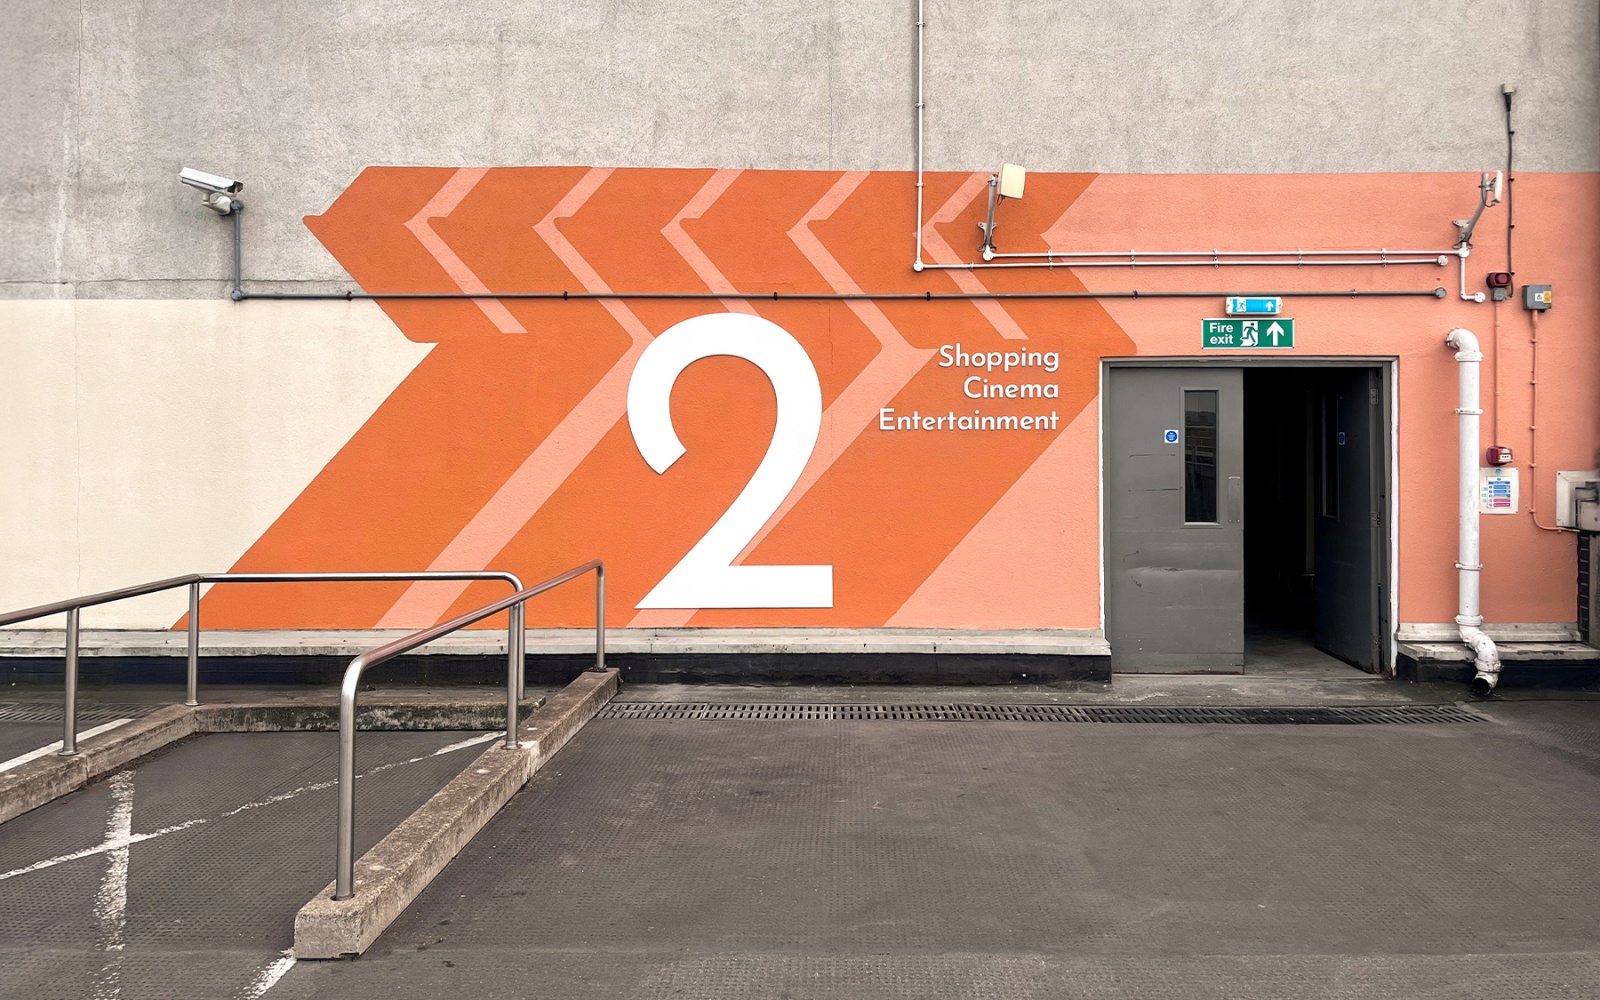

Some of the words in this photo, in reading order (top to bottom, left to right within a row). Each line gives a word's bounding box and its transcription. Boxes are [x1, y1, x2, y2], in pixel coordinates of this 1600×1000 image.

[1209, 322, 1234, 333] Fire
[1209, 334, 1234, 345] exit
[938, 343, 1059, 372] Shopping
[963, 376, 1059, 398] Cinema
[879, 407, 1060, 431] Entertainment
[627, 312, 833, 608] 2
